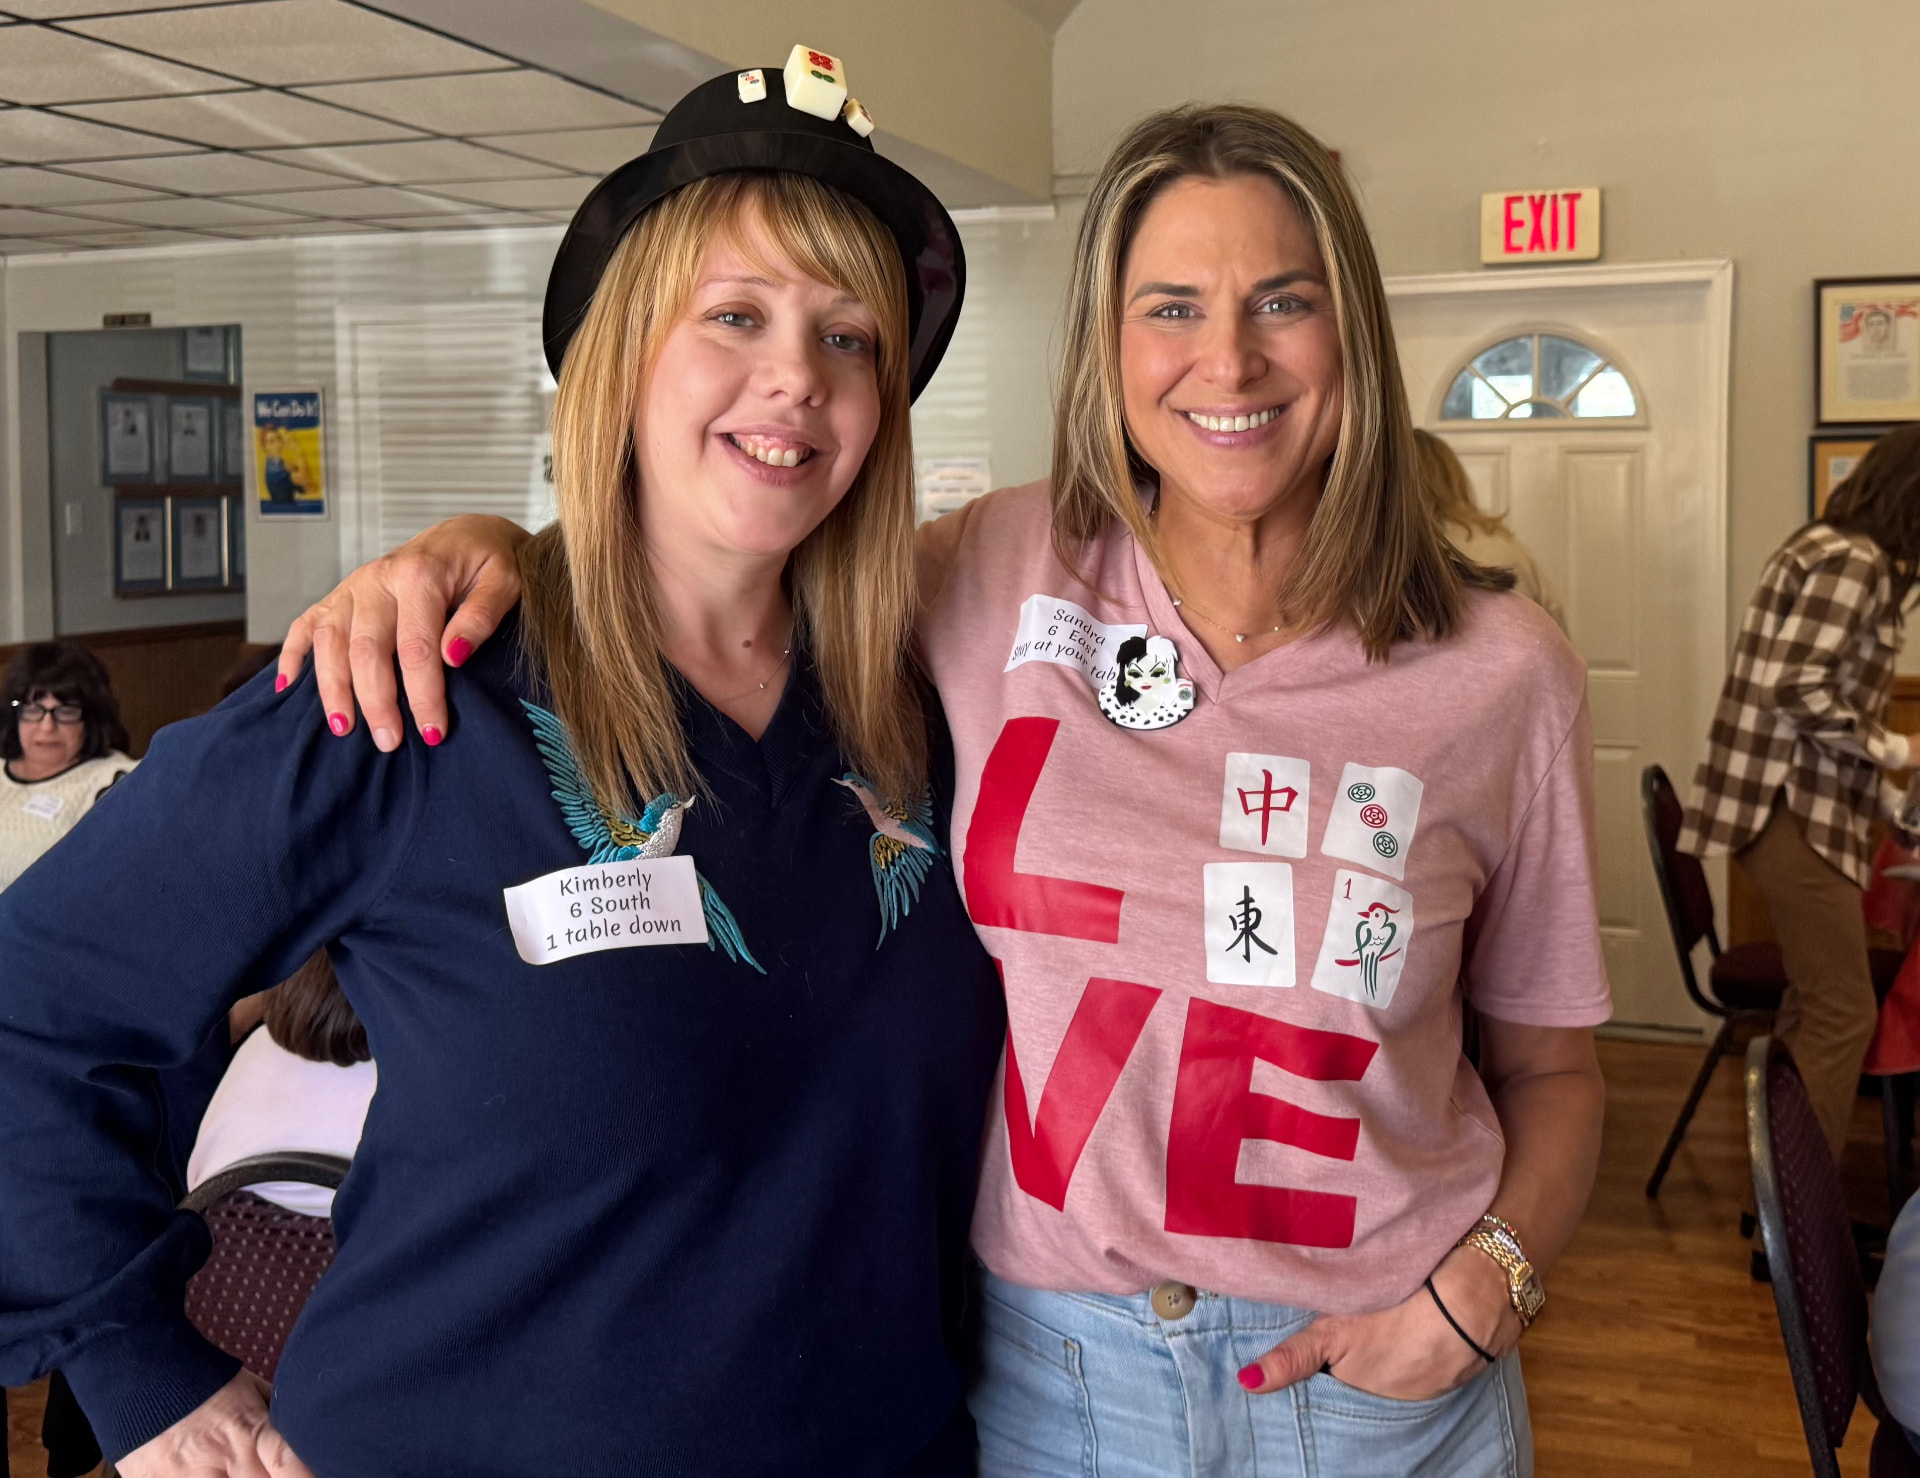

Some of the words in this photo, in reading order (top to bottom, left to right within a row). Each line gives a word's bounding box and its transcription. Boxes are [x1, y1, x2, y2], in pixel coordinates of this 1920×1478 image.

[1504, 193, 1582, 254] EXIT
[1048, 625, 1059, 636] 6
[1068, 630, 1098, 657] East
[1053, 609, 1105, 646] Sandra
[1034, 640, 1052, 651] at
[1058, 644, 1088, 665] your
[1090, 666, 1117, 681] tab
[1237, 768, 1299, 847] 中
[560, 868, 652, 897] Kimberly
[1343, 878, 1352, 900] 1
[570, 902, 582, 918] 6
[591, 891, 651, 915] South
[546, 934, 558, 952] 1
[565, 917, 621, 945] table
[629, 914, 681, 935] down
[1225, 885, 1279, 963] 東
